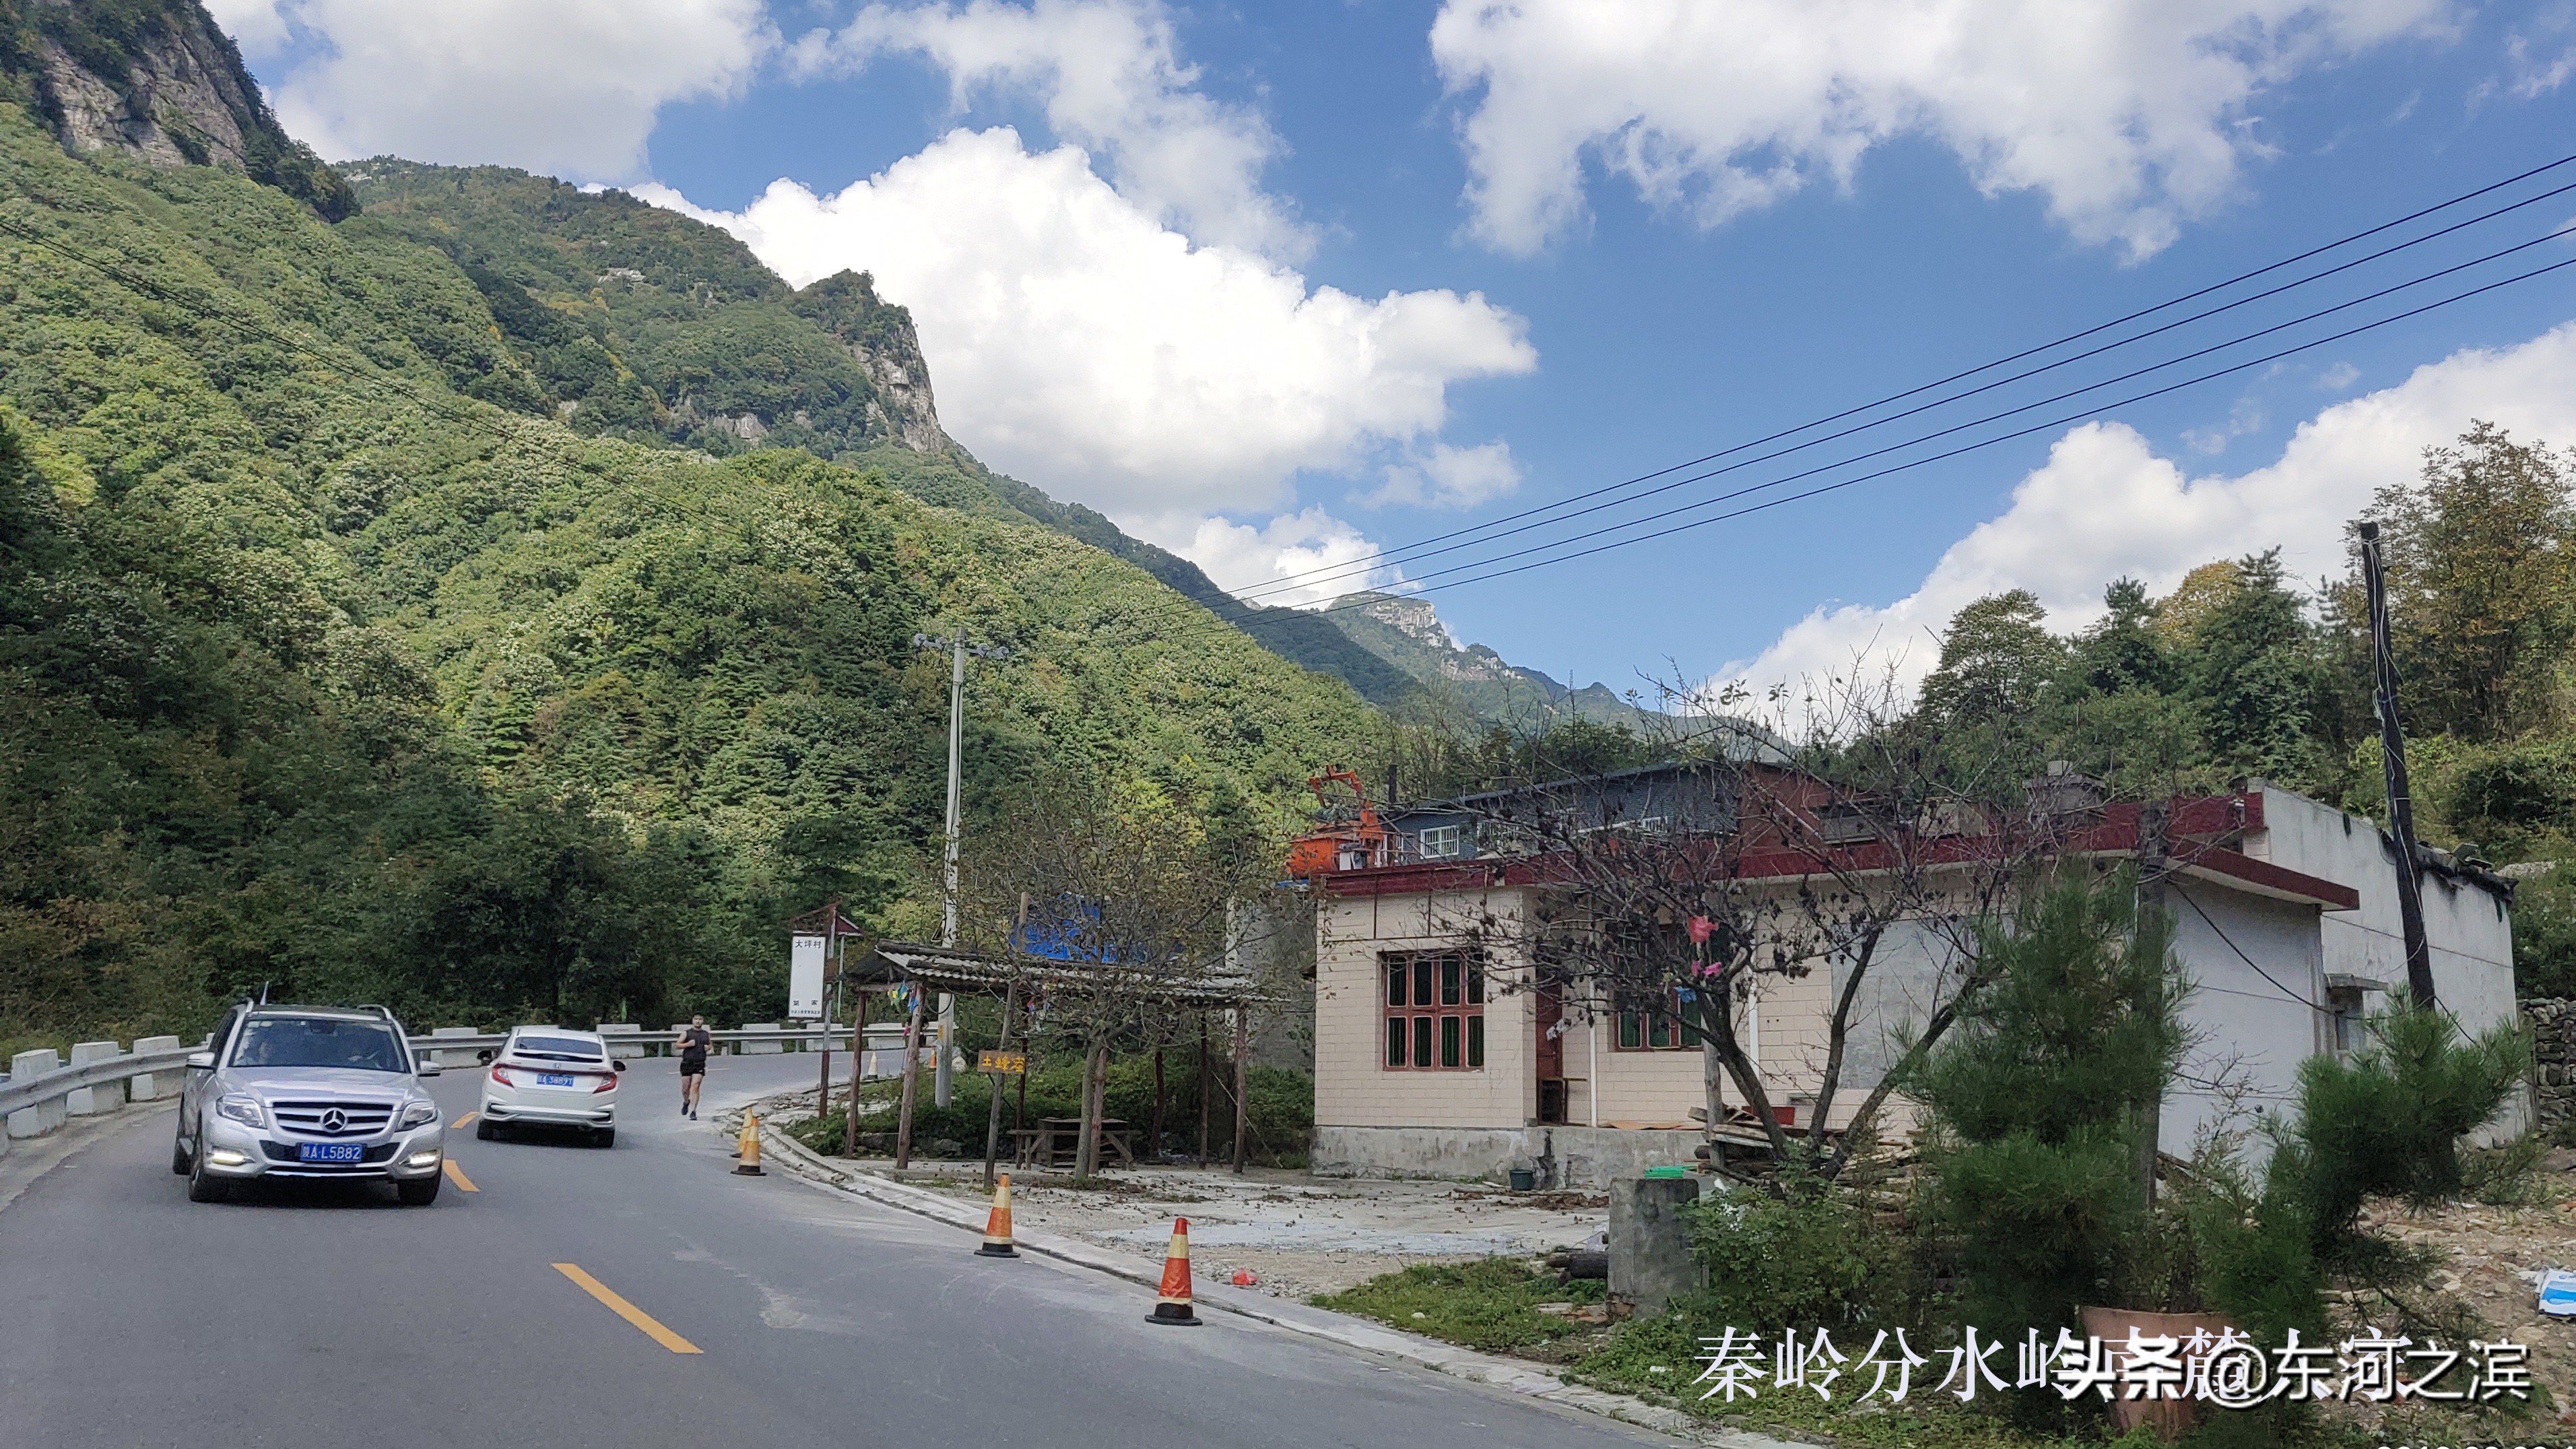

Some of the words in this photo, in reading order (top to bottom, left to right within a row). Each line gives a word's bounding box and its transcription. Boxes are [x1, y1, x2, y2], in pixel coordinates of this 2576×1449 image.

[795, 940, 822, 949] 大坪村
[982, 1054, 1024, 1073] 土蜂蜜
